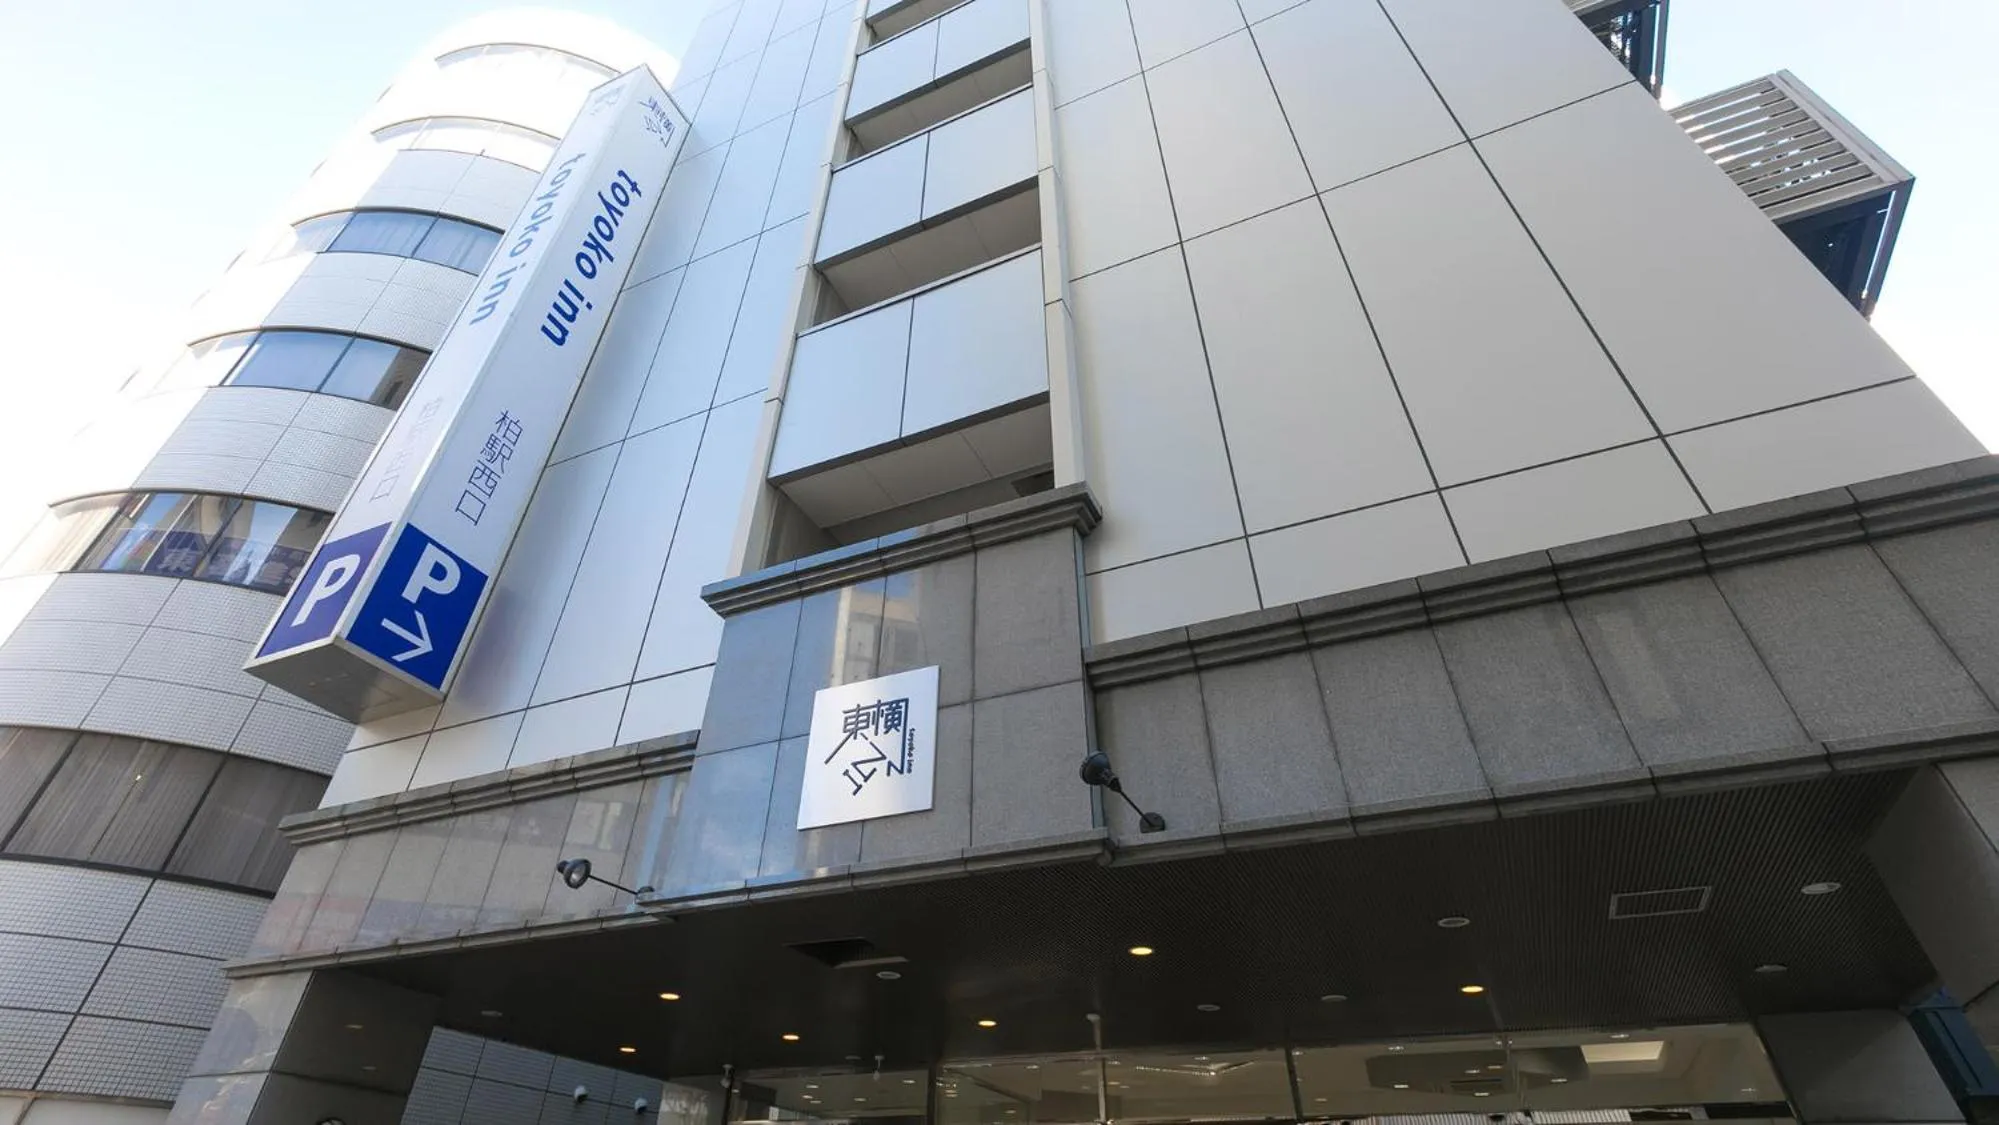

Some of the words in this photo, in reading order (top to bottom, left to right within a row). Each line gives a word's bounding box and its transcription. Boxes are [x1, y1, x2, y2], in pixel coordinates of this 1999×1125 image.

[508, 153, 586, 259] toyoko
[574, 169, 642, 280] toyoko
[469, 262, 527, 326] inn
[540, 278, 593, 347] inn
[455, 410, 524, 526] 柏駅西口
[290, 554, 361, 628] P
[401, 542, 461, 604] P
